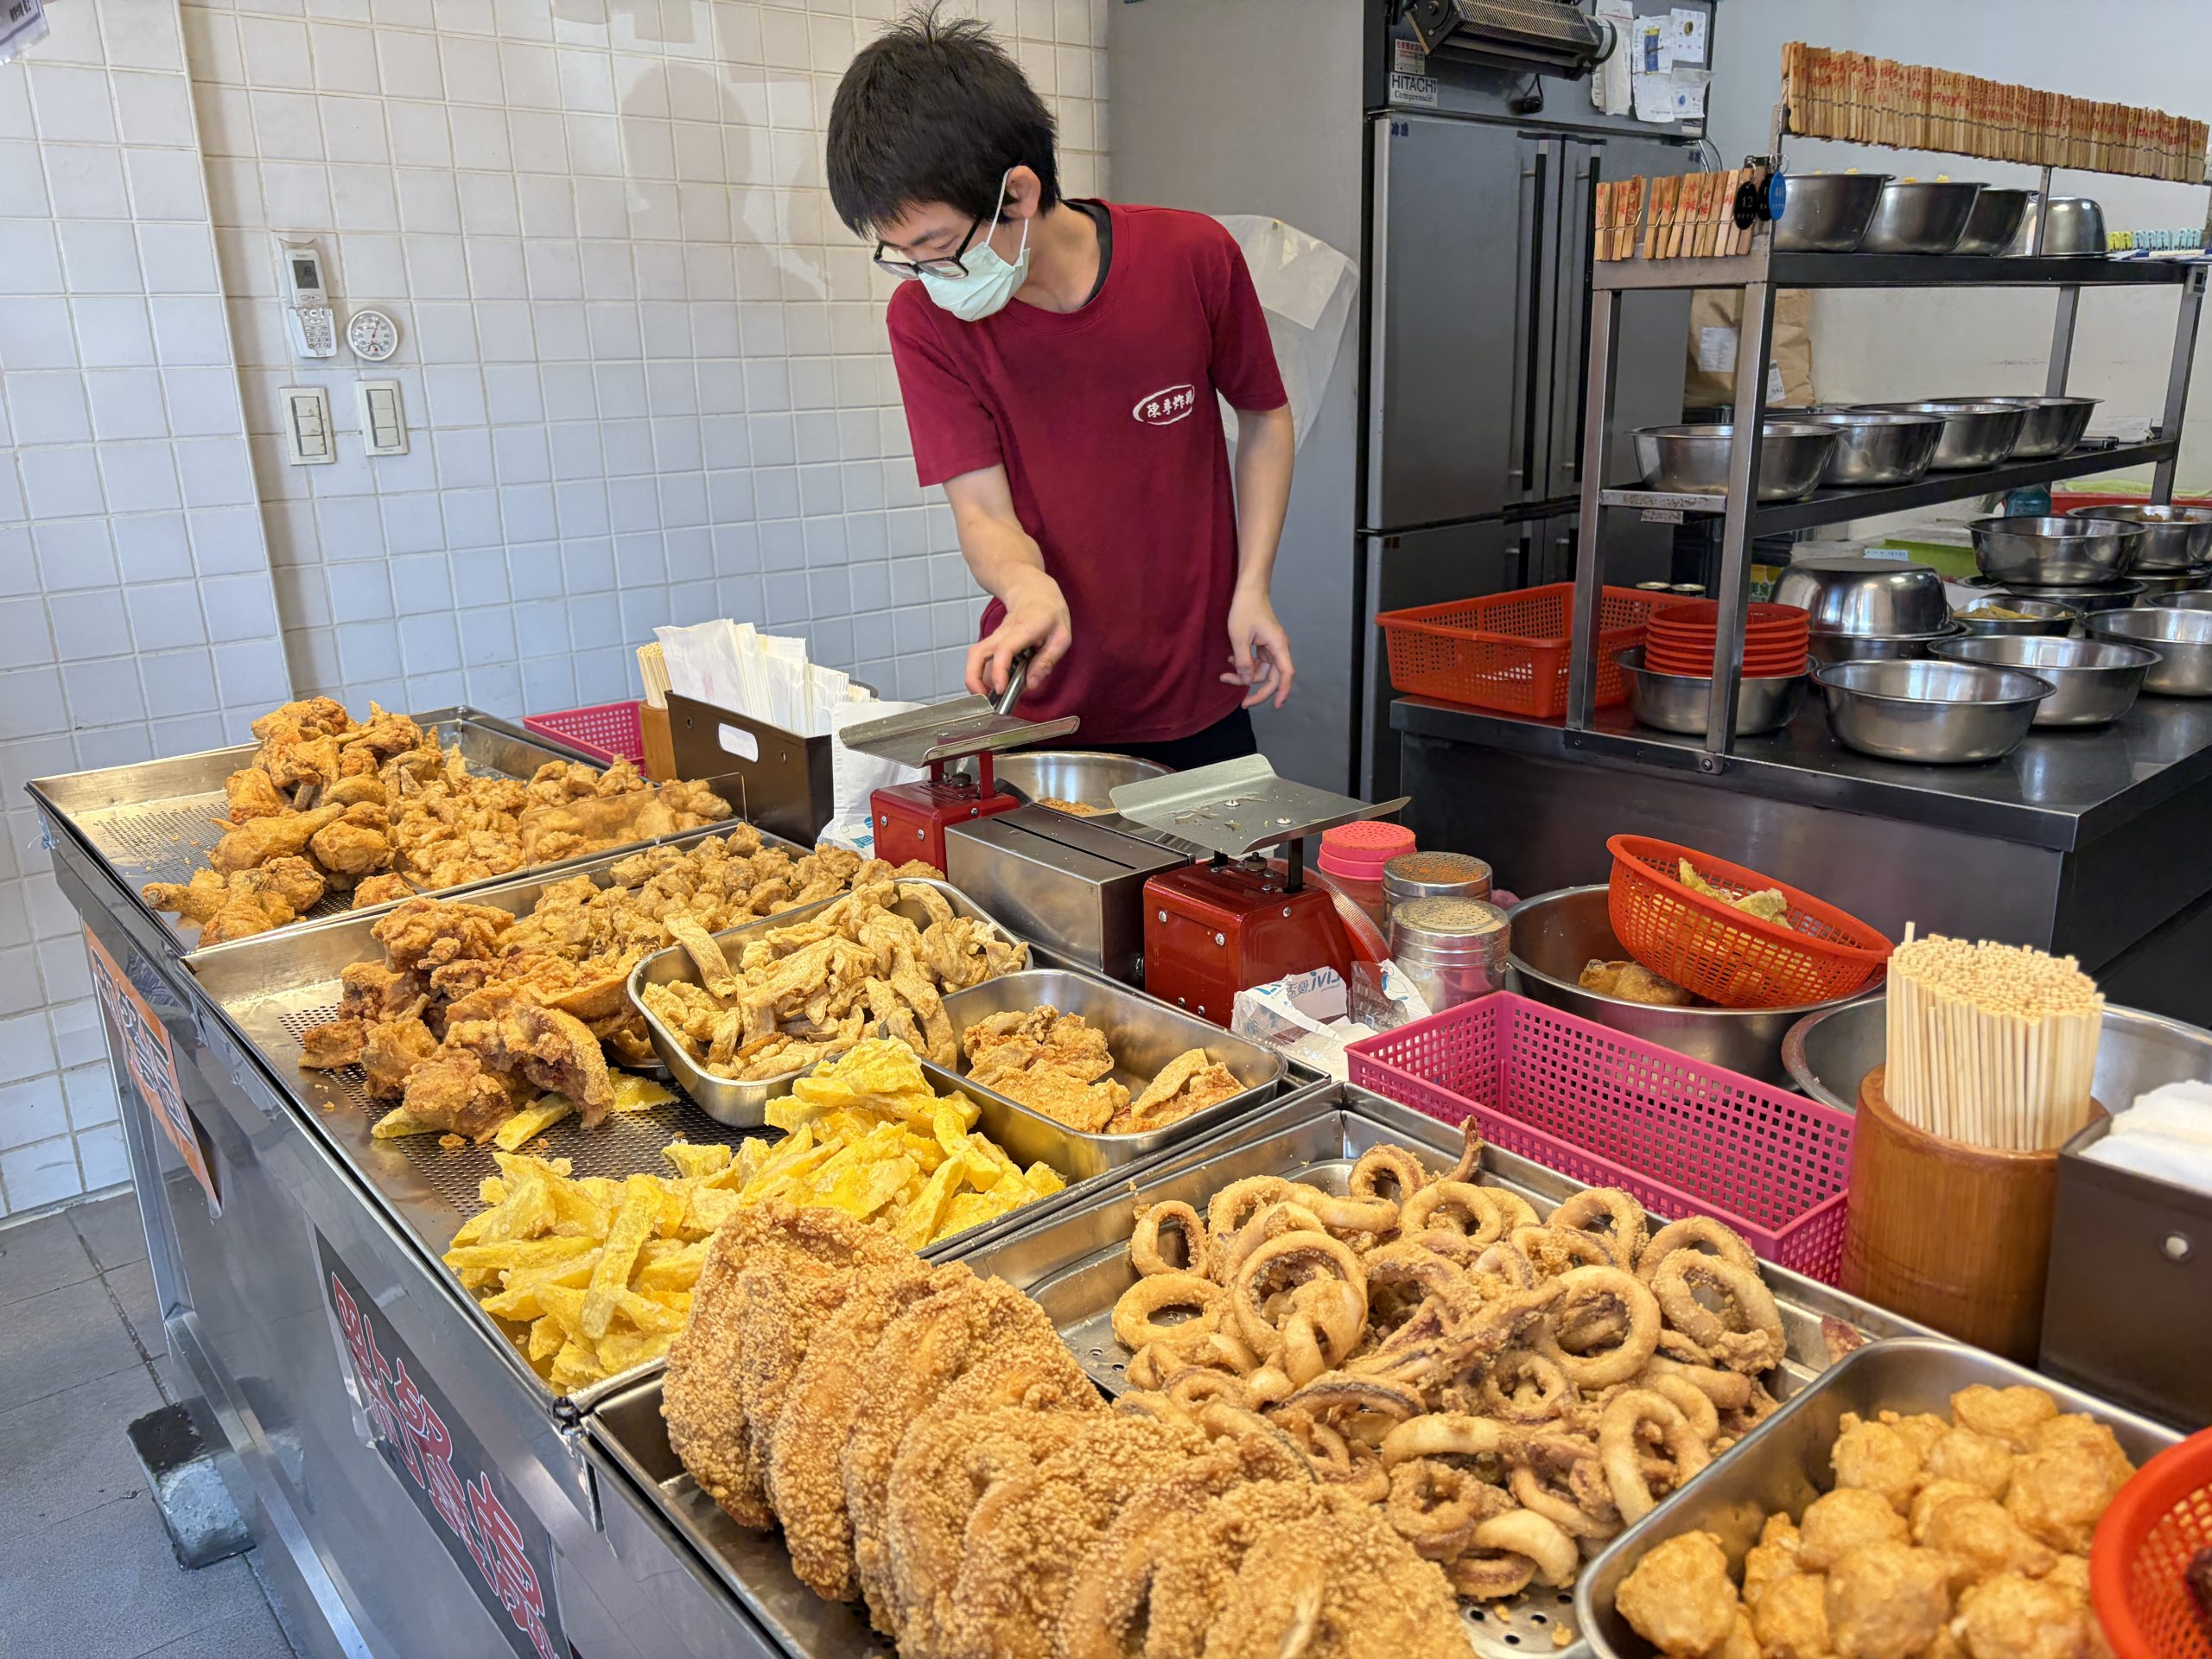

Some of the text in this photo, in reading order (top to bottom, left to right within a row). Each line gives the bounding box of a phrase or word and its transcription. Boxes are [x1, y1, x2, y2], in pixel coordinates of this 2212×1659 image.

[1392, 74, 1436, 93] HITACHI
[1741, 195, 1753, 208] 12
[332, 1271, 559, 1659] 點餐處
